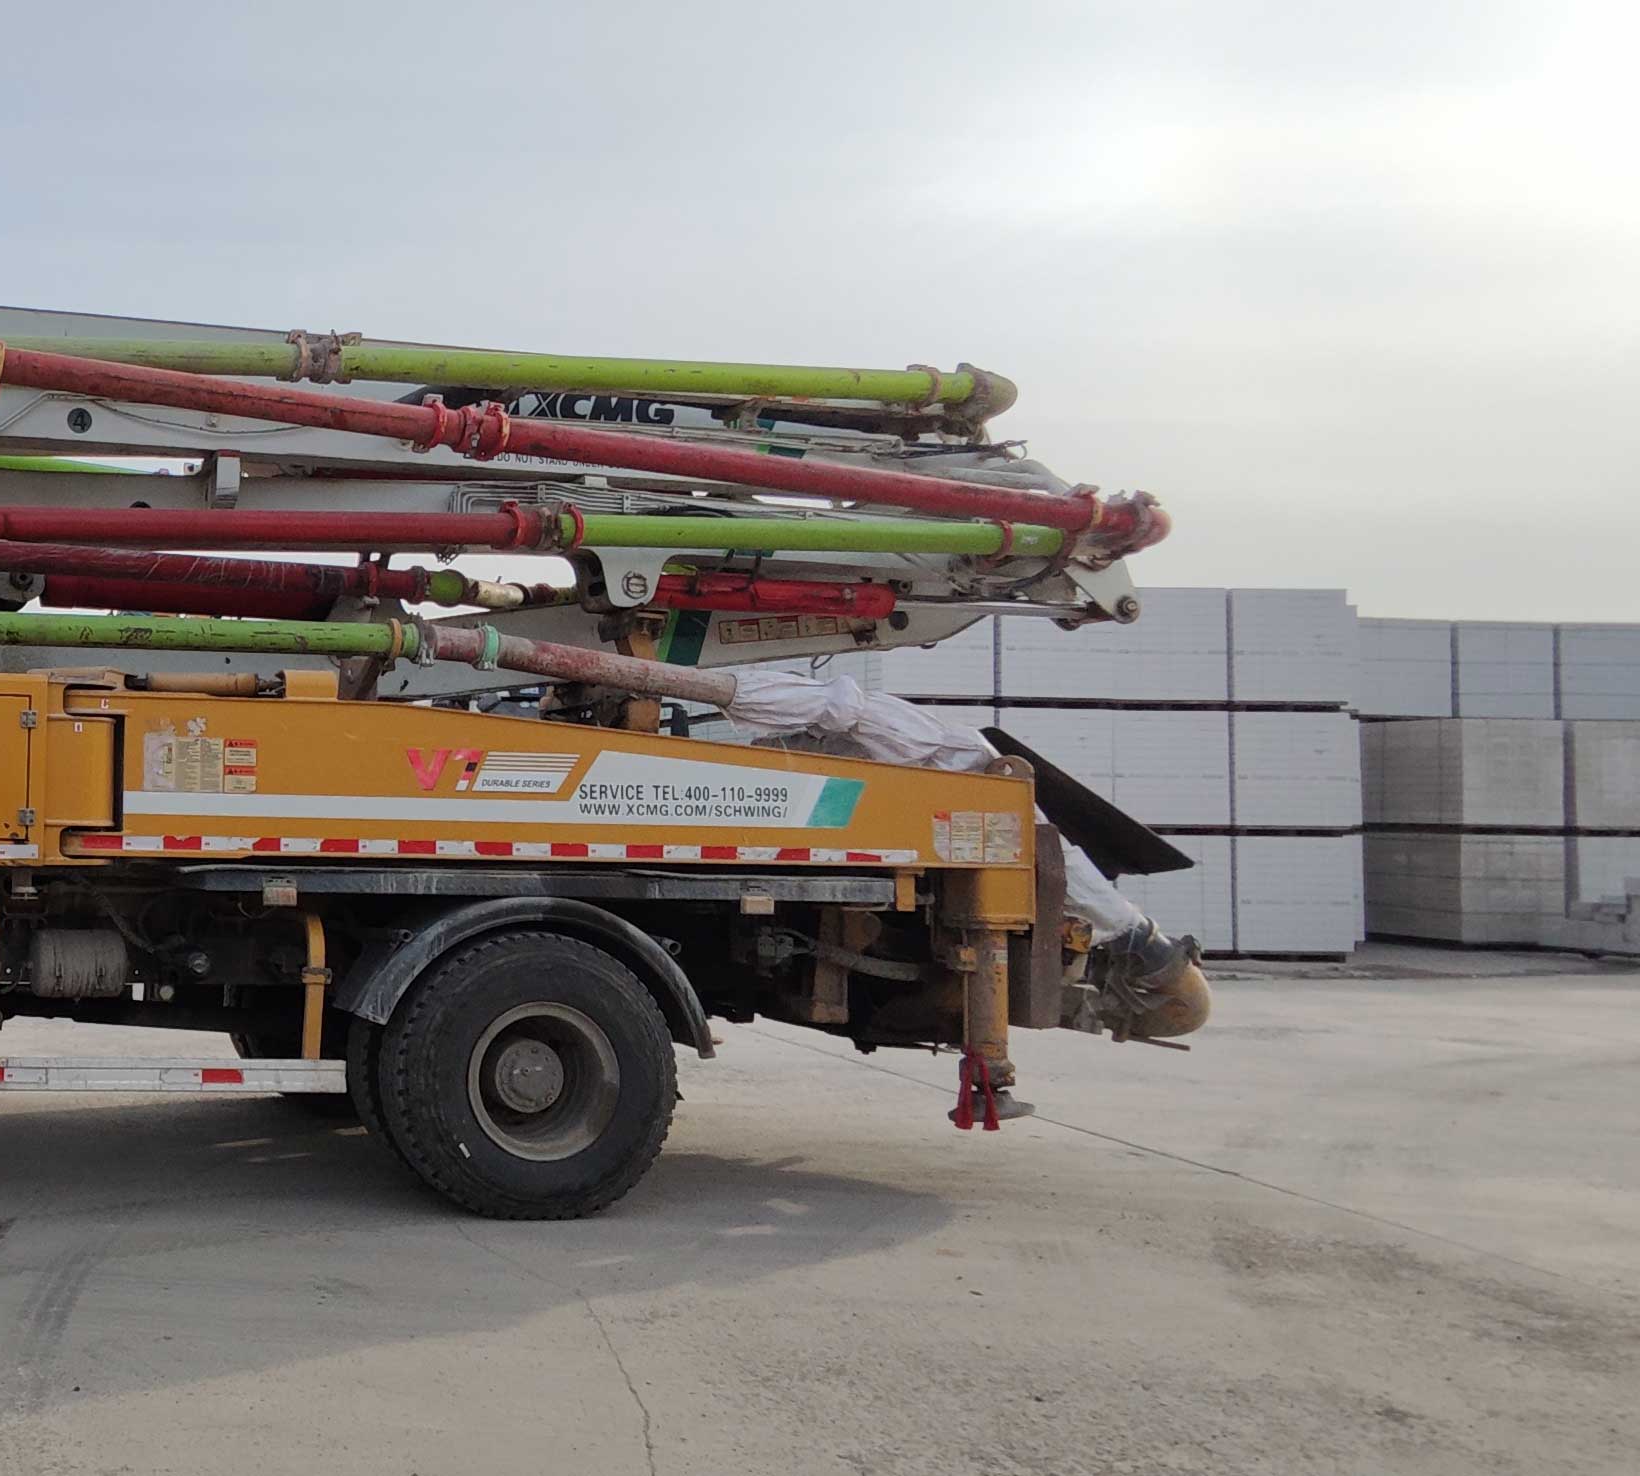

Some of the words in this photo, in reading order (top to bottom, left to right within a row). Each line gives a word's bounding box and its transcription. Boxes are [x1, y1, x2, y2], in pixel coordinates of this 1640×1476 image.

[528, 392, 675, 425] XCMG
[481, 778, 520, 788] DURABLE
[522, 780, 551, 788] SERIES
[579, 784, 644, 800] SERVICE
[653, 785, 788, 802] TEL:400-110-9999
[579, 803, 788, 818] WWW.XCMG.COM/SCHWING/
